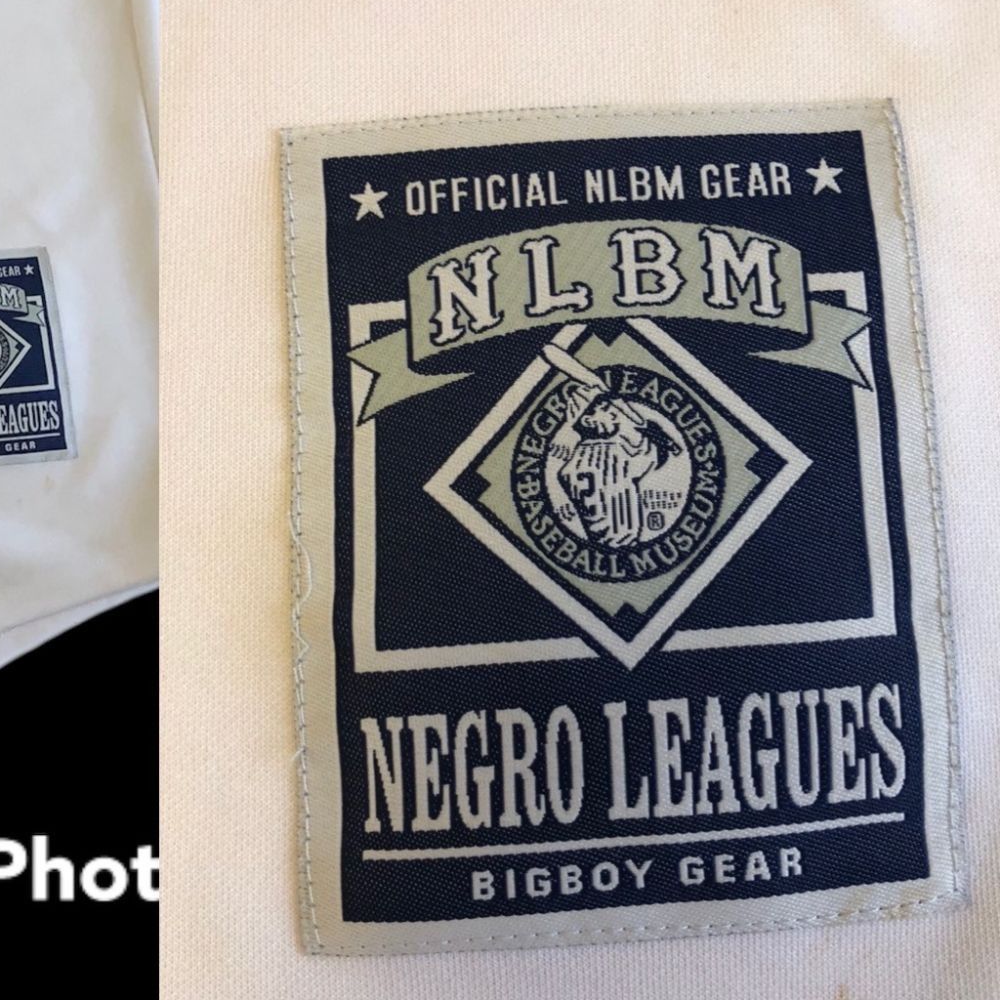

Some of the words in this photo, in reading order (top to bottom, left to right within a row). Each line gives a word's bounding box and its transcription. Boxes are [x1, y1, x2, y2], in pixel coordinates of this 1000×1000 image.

[405, 171, 568, 217] OFFICIAL
[585, 164, 686, 204] NLBM
[699, 161, 793, 200] GEAR
[427, 226, 786, 347] NLBM
[4, 440, 37, 452] GEAR
[516, 475, 627, 578] BASEBALL
[628, 469, 720, 578] MUSEUM
[360, 703, 586, 833] NEGRO
[603, 682, 907, 821] LEAGUES
[471, 858, 654, 901] BIGBOY
[679, 847, 803, 887] GEAR
